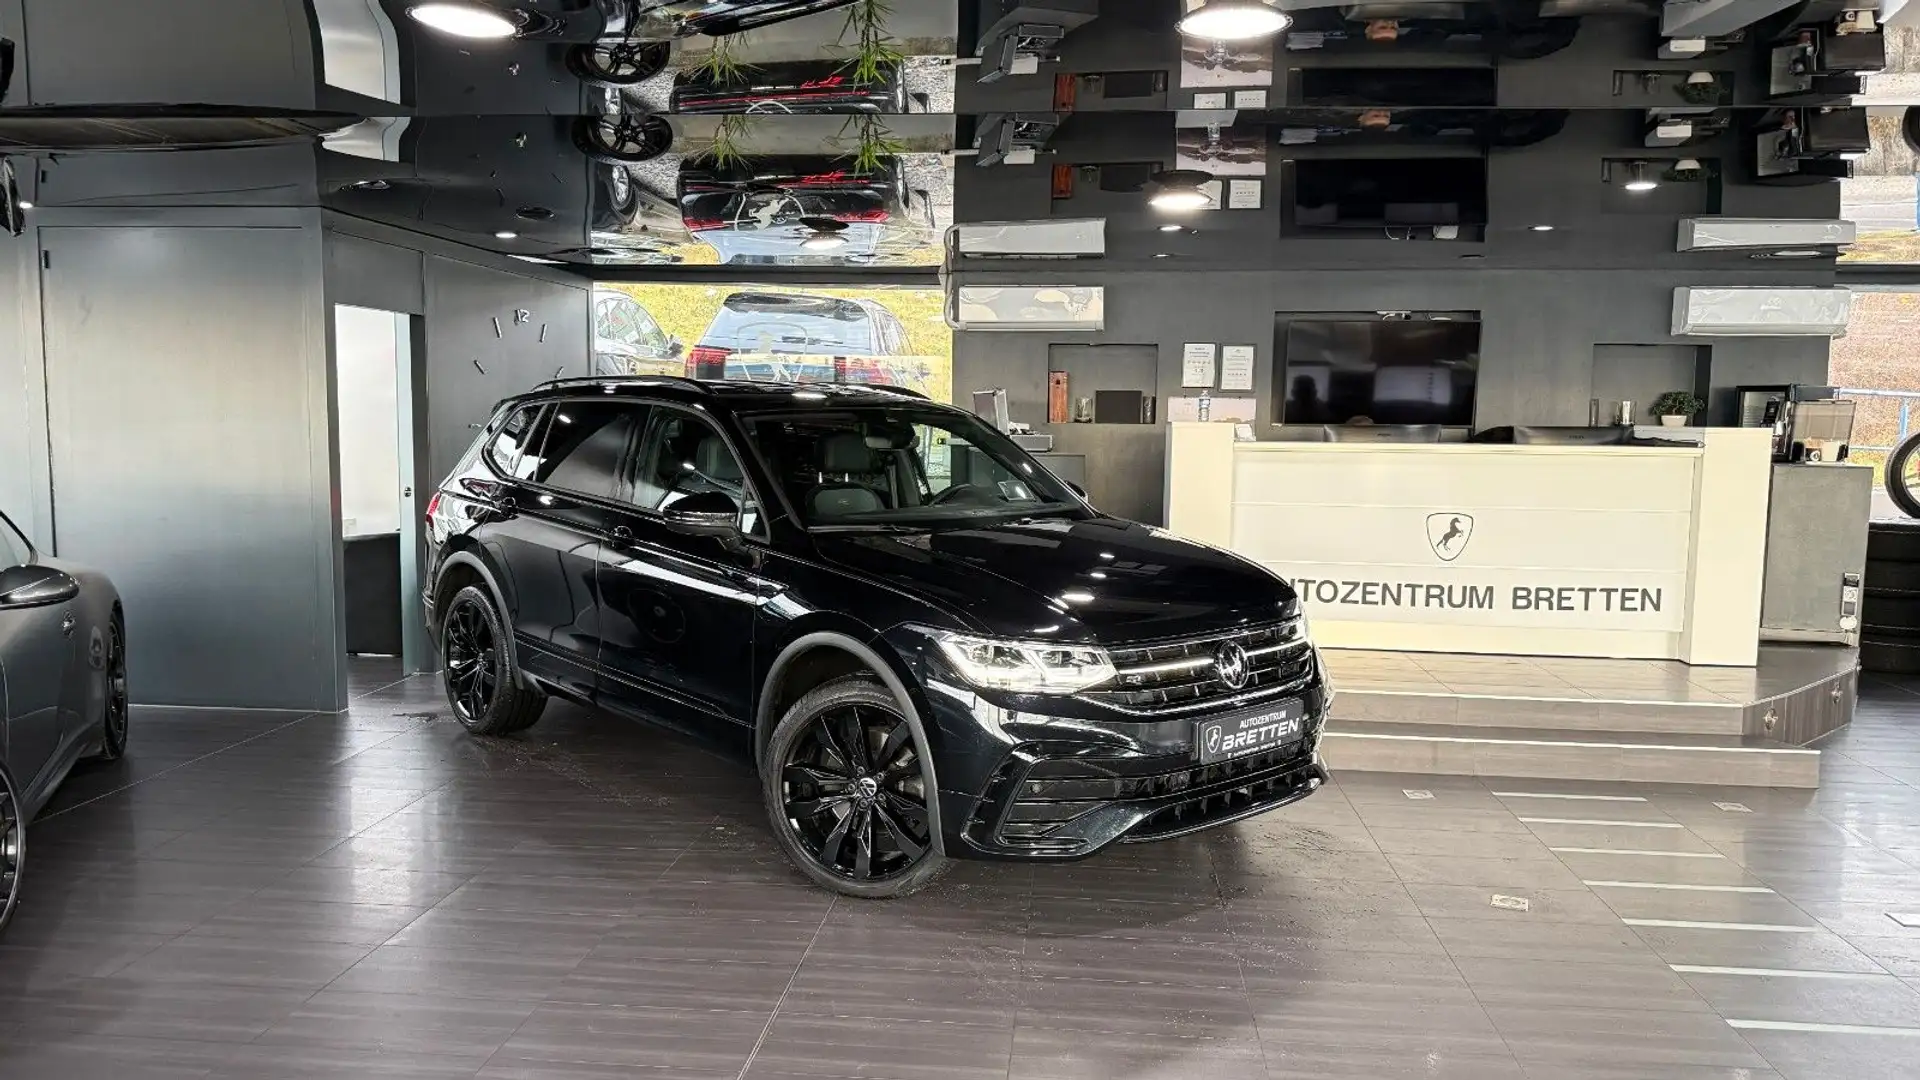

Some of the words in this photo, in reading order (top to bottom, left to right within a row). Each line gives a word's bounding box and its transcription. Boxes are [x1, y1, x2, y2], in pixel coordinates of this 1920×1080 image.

[516, 308, 530, 323] 12
[1289, 578, 1494, 609] TOZENTRUM
[1511, 586, 1663, 612] BRETTEN
[1239, 709, 1287, 730] AUTOZENTRUM
[1222, 717, 1300, 751] BRETTEN
